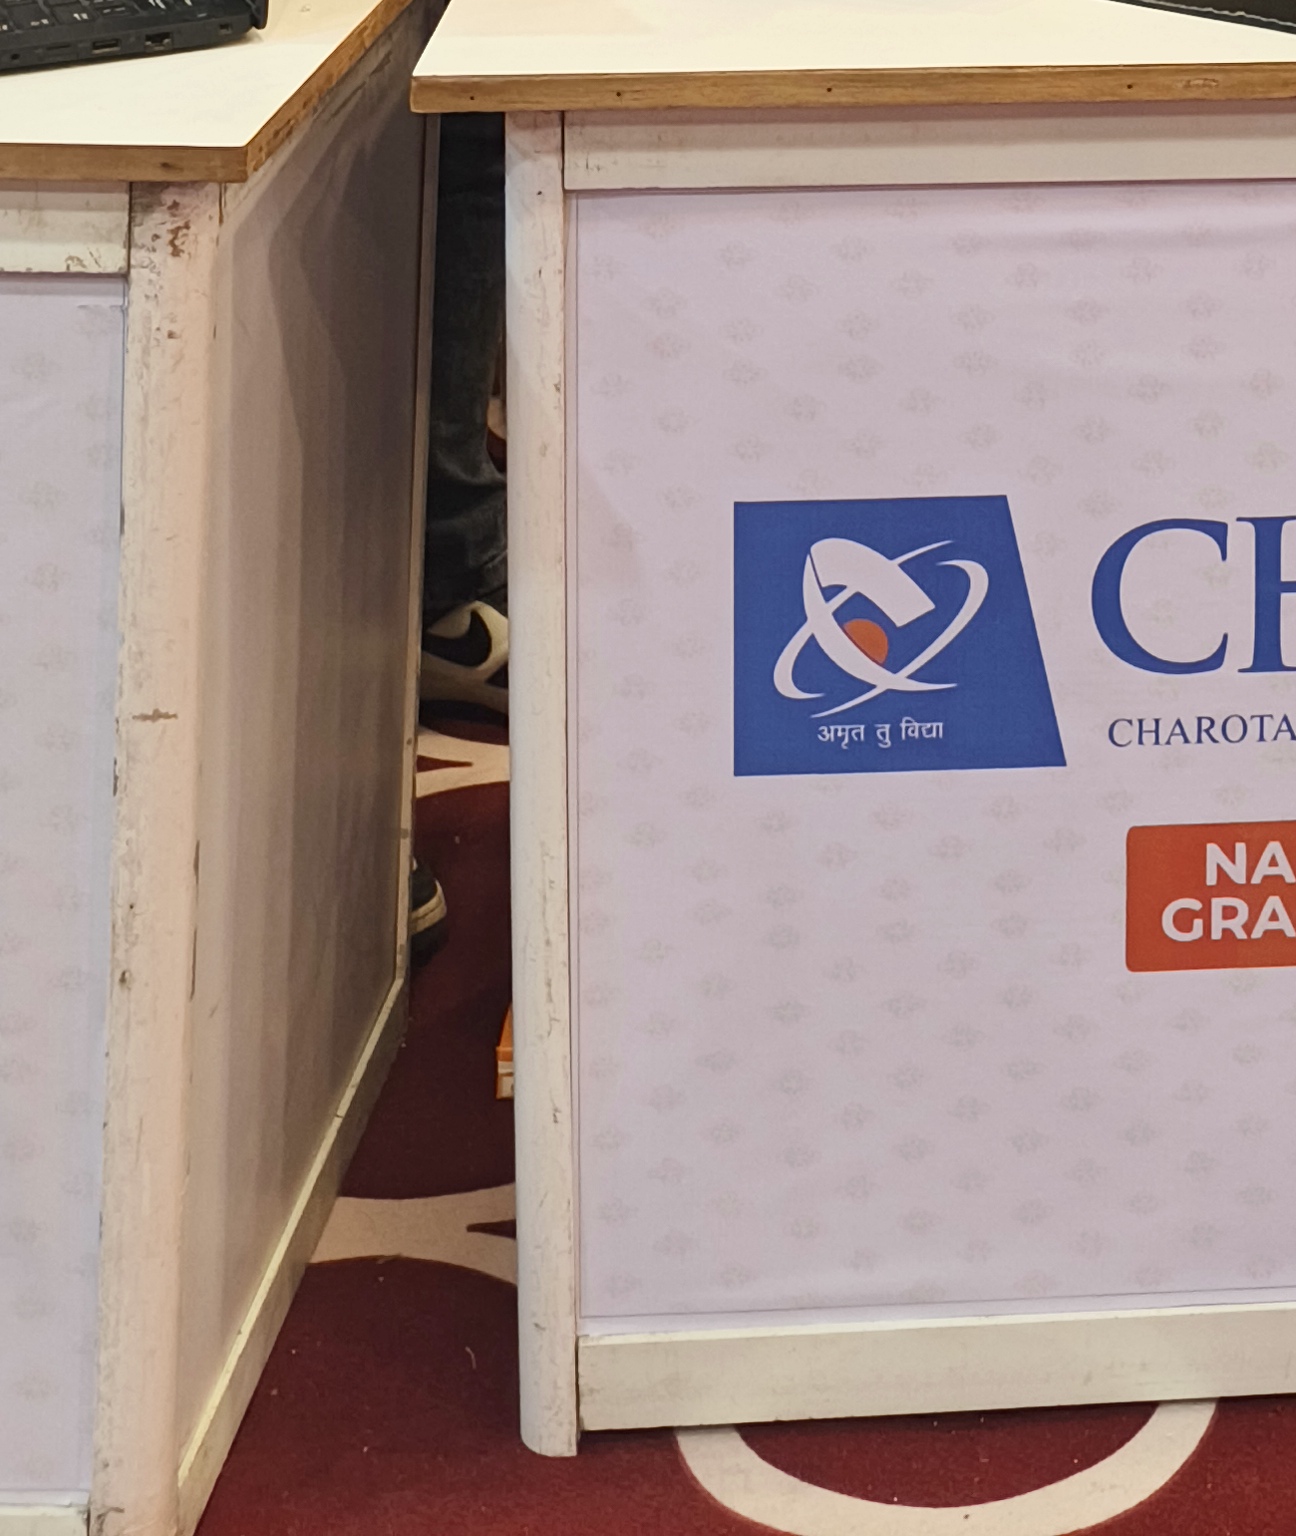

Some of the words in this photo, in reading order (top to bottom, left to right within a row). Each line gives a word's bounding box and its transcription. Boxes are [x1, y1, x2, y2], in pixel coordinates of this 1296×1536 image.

[817, 724, 865, 750] अमृत
[874, 723, 892, 748] तु
[900, 716, 943, 742] विद्या
